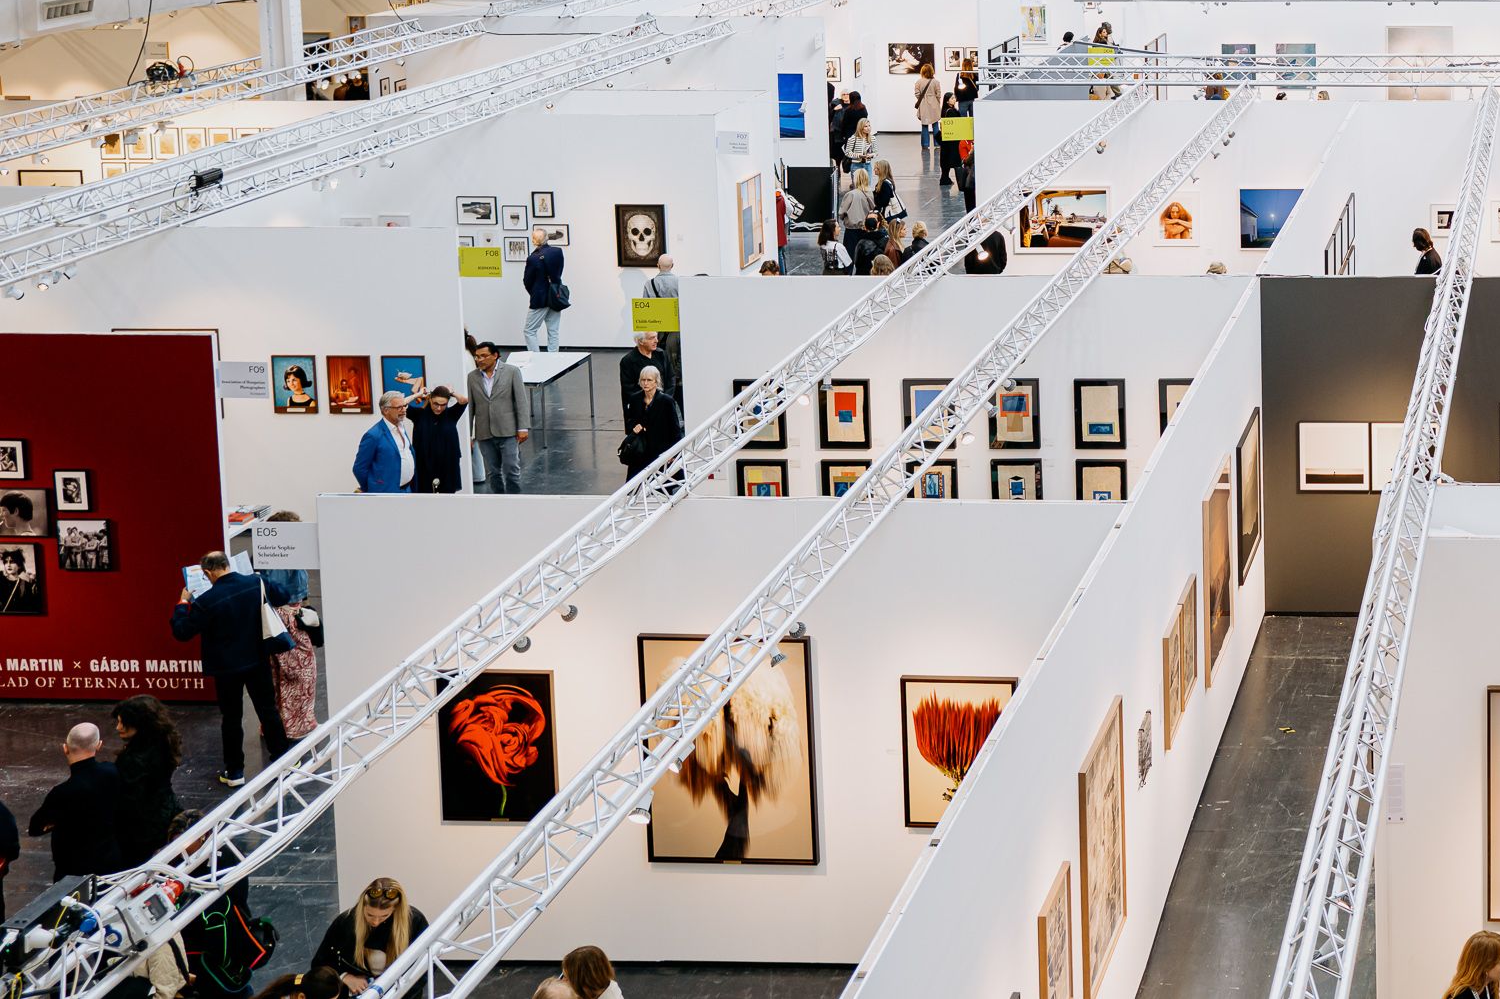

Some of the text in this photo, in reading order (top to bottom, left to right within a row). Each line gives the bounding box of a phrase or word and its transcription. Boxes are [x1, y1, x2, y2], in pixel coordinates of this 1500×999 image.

[634, 301, 650, 309] E04
[248, 365, 265, 373] F09
[256, 527, 278, 537] E05
[277, 544, 296, 552] Sophie
[6, 658, 64, 672] MARTIN
[89, 656, 140, 673] GÁBOR
[145, 659, 204, 673] MARTIN
[35, 677, 57, 688] OF
[62, 677, 140, 689] ETERNAL
[145, 677, 205, 689] YOUTH
